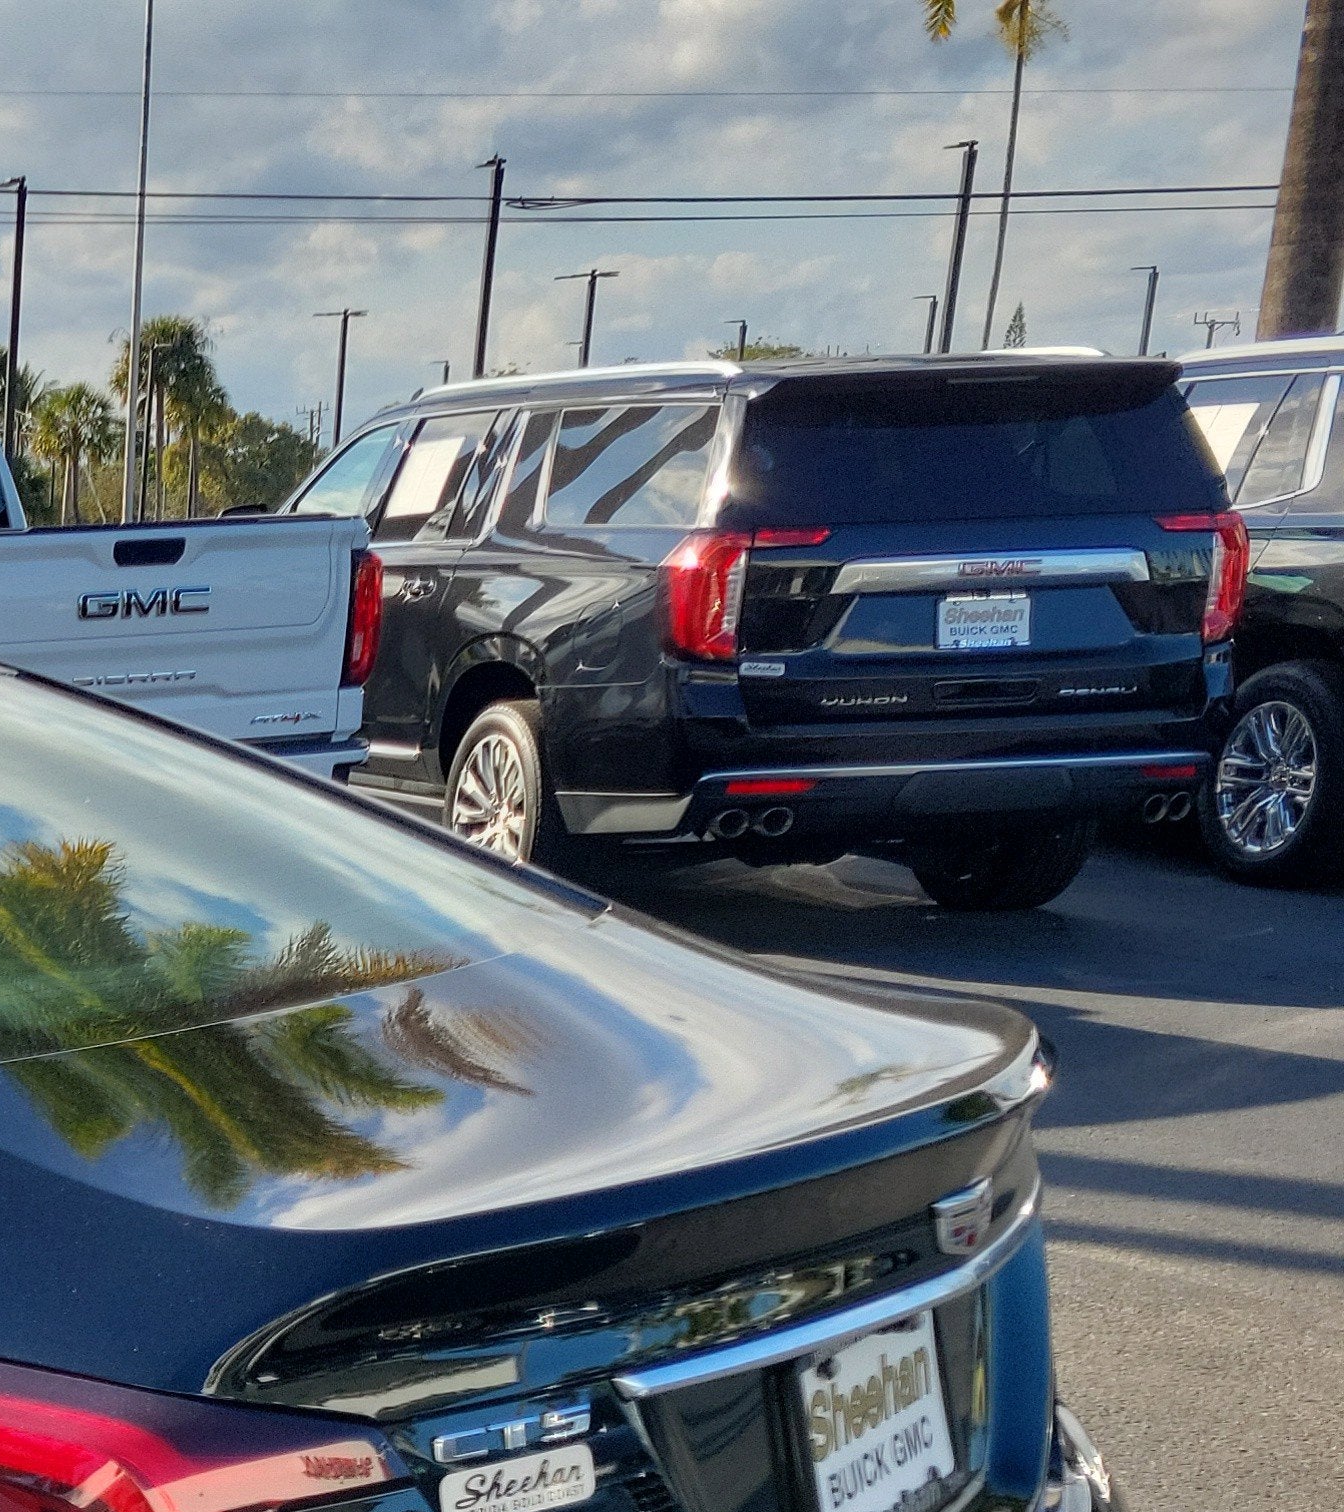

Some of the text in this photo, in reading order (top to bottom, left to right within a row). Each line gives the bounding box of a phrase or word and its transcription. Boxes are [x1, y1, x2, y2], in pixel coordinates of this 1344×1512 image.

[958, 558, 1042, 577] GMC
[77, 584, 211, 621] GMC
[944, 606, 1025, 624] Sheehan
[949, 624, 1018, 636] BUICK GMC
[820, 694, 908, 706] YUKON
[810, 1347, 932, 1463] Sheehan
[827, 1415, 934, 1510] BUICK GMC
[455, 1459, 586, 1510] Sheehan
